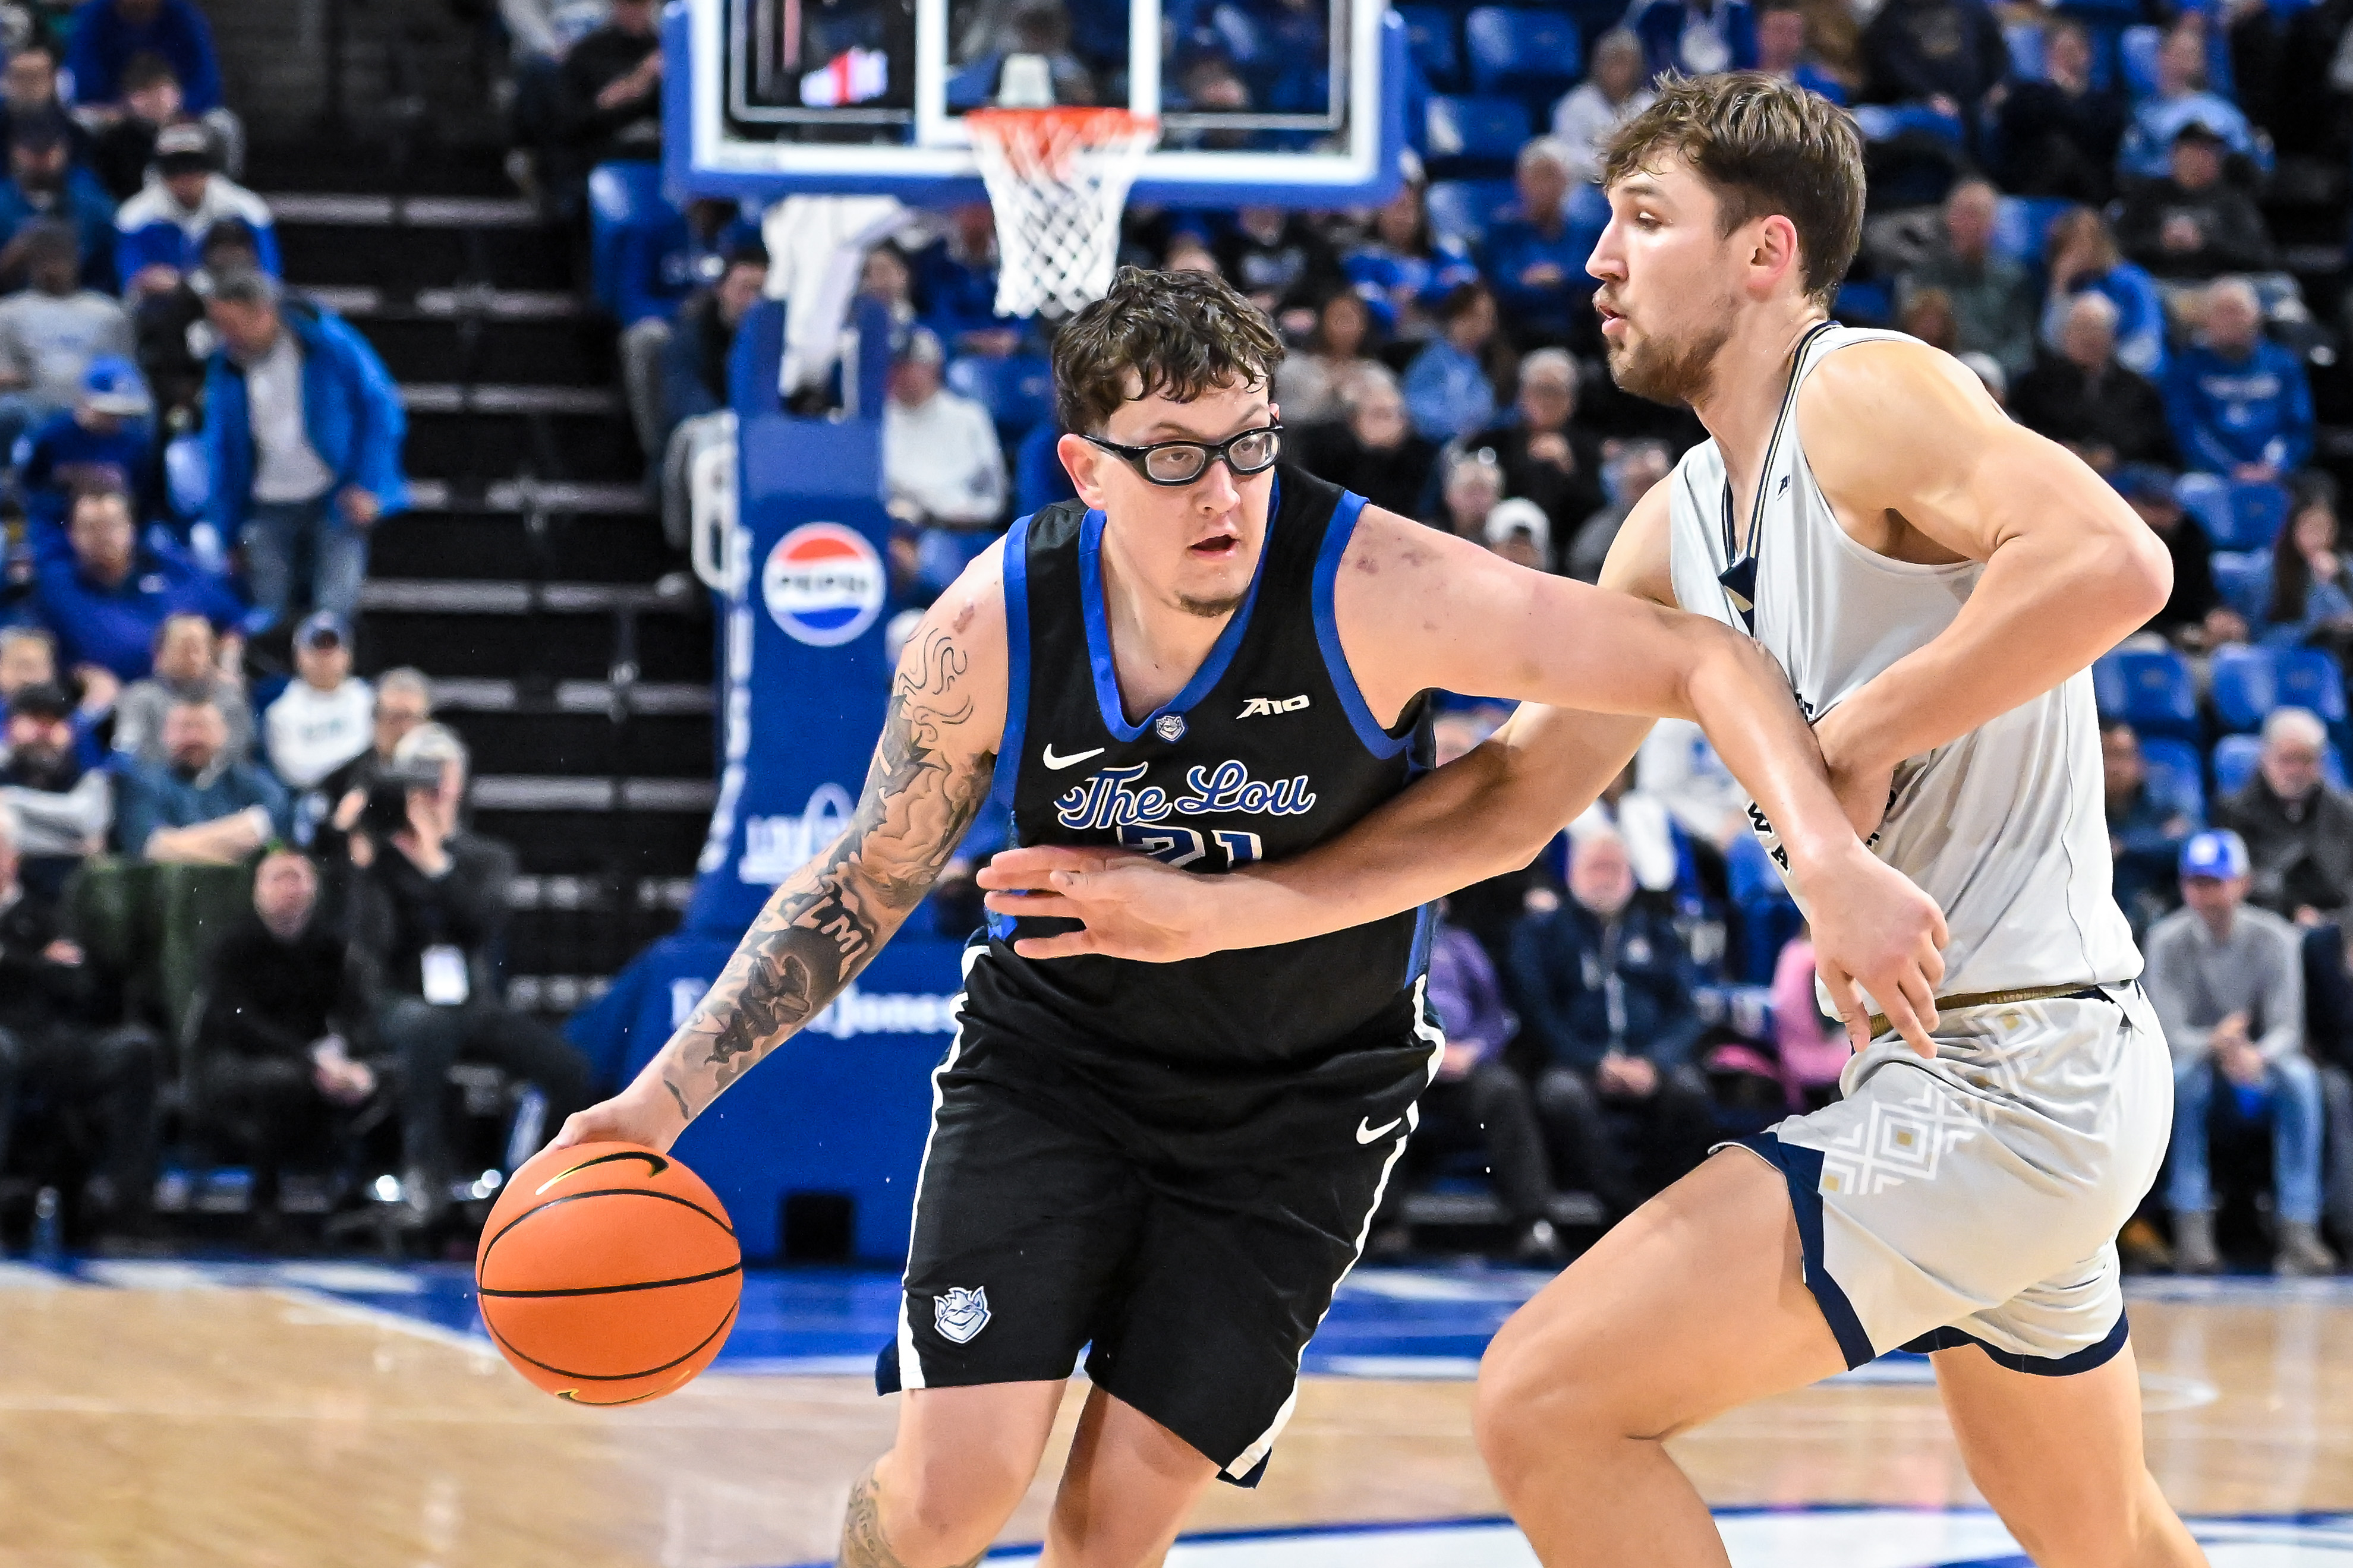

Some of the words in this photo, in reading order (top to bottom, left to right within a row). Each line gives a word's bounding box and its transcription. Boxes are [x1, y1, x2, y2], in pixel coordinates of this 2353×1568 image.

[1236, 695, 1310, 720] A10
[1054, 761, 1173, 829] The
[1174, 759, 1316, 816] Lou
